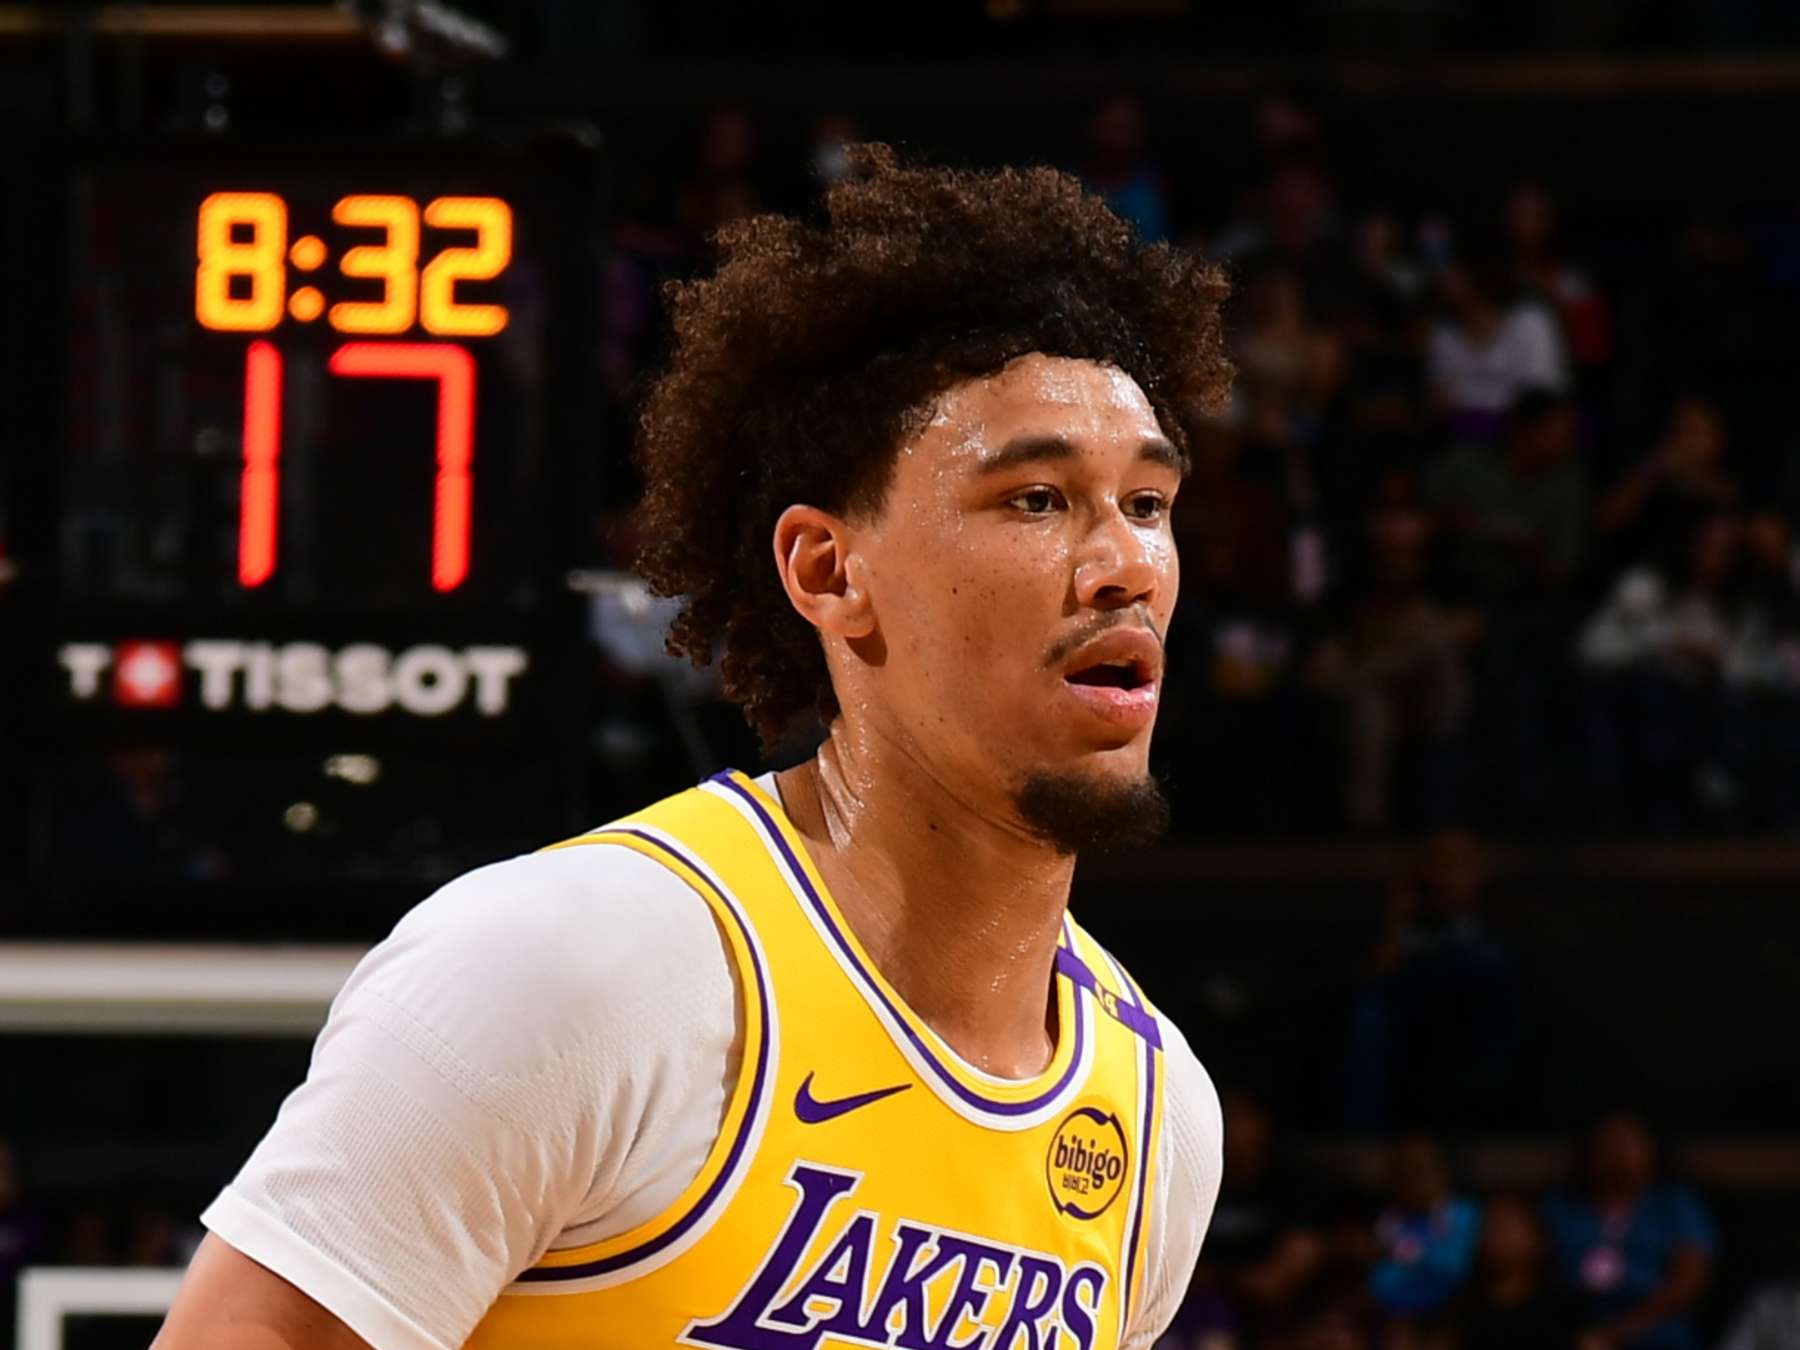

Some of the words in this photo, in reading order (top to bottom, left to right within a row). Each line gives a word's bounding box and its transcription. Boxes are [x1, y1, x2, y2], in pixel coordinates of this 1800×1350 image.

[196, 191, 514, 337] 8:32
[237, 339, 477, 593] 17
[186, 640, 526, 714] TISSOT
[1054, 1134, 1121, 1190] bibigo
